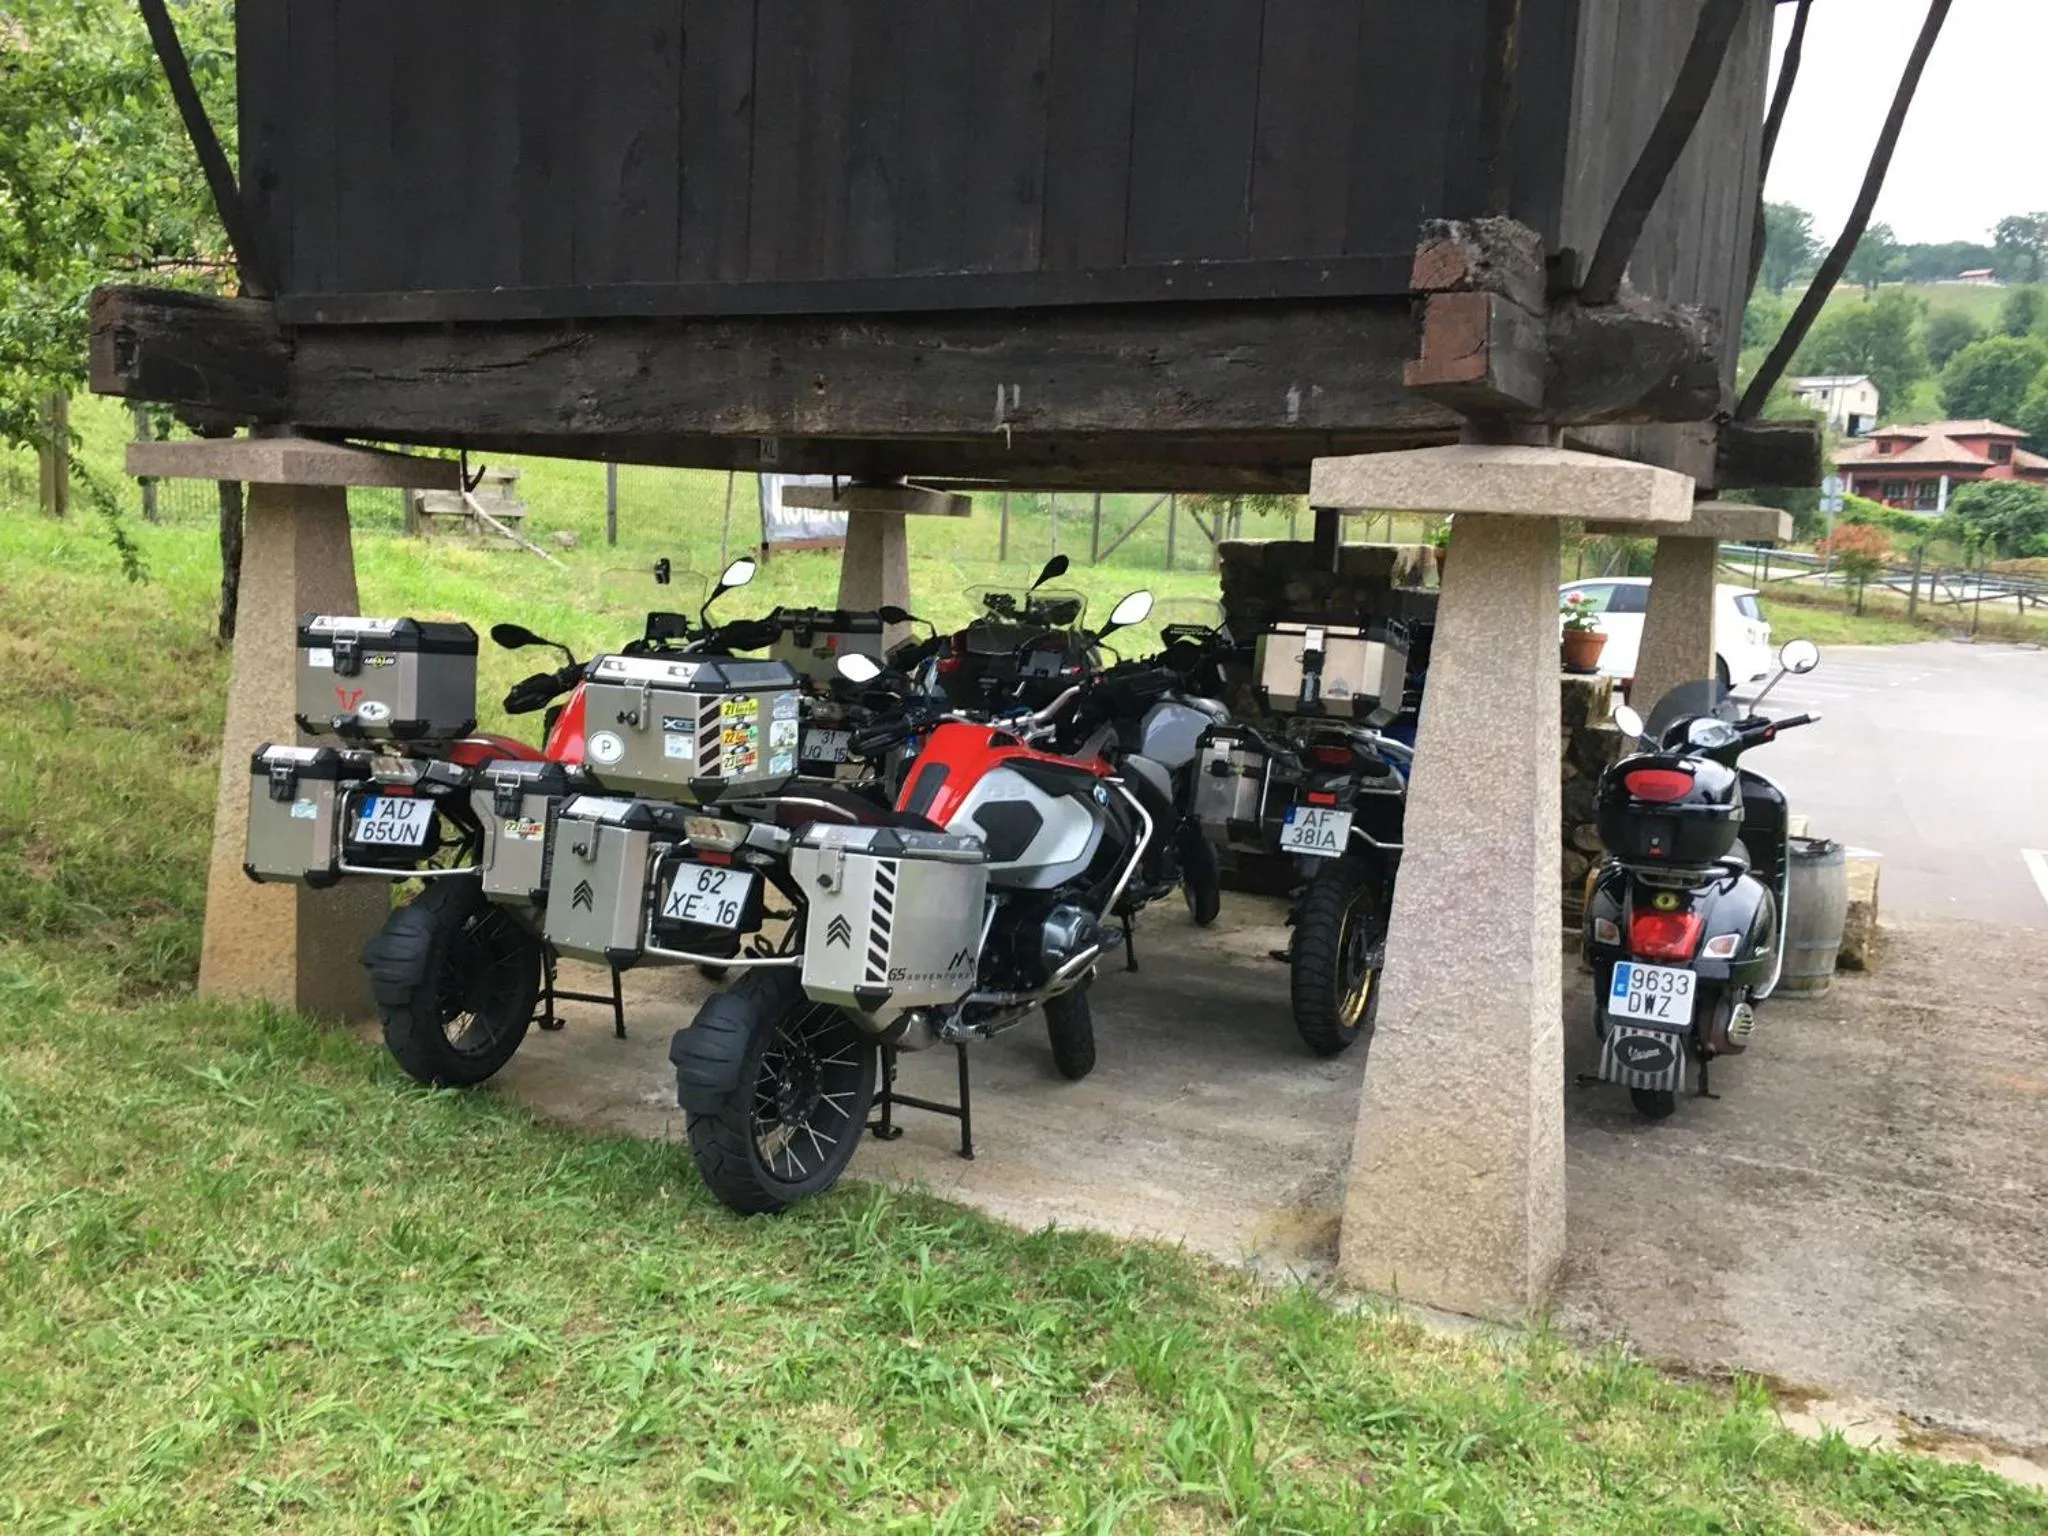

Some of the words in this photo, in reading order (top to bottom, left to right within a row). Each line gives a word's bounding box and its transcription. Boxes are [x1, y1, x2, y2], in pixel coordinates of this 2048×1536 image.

[601, 739, 612, 754] P
[821, 731, 836, 744] 31
[380, 800, 415, 820] AD
[1302, 810, 1335, 828] AF
[362, 821, 420, 843] 65UN
[1292, 827, 1336, 849] 38IA
[697, 868, 727, 895] 62
[666, 891, 704, 919] XE
[715, 899, 738, 925] 16
[888, 967, 907, 981] GS
[1631, 968, 1690, 996] 9633
[1627, 991, 1672, 1018] DWZ
